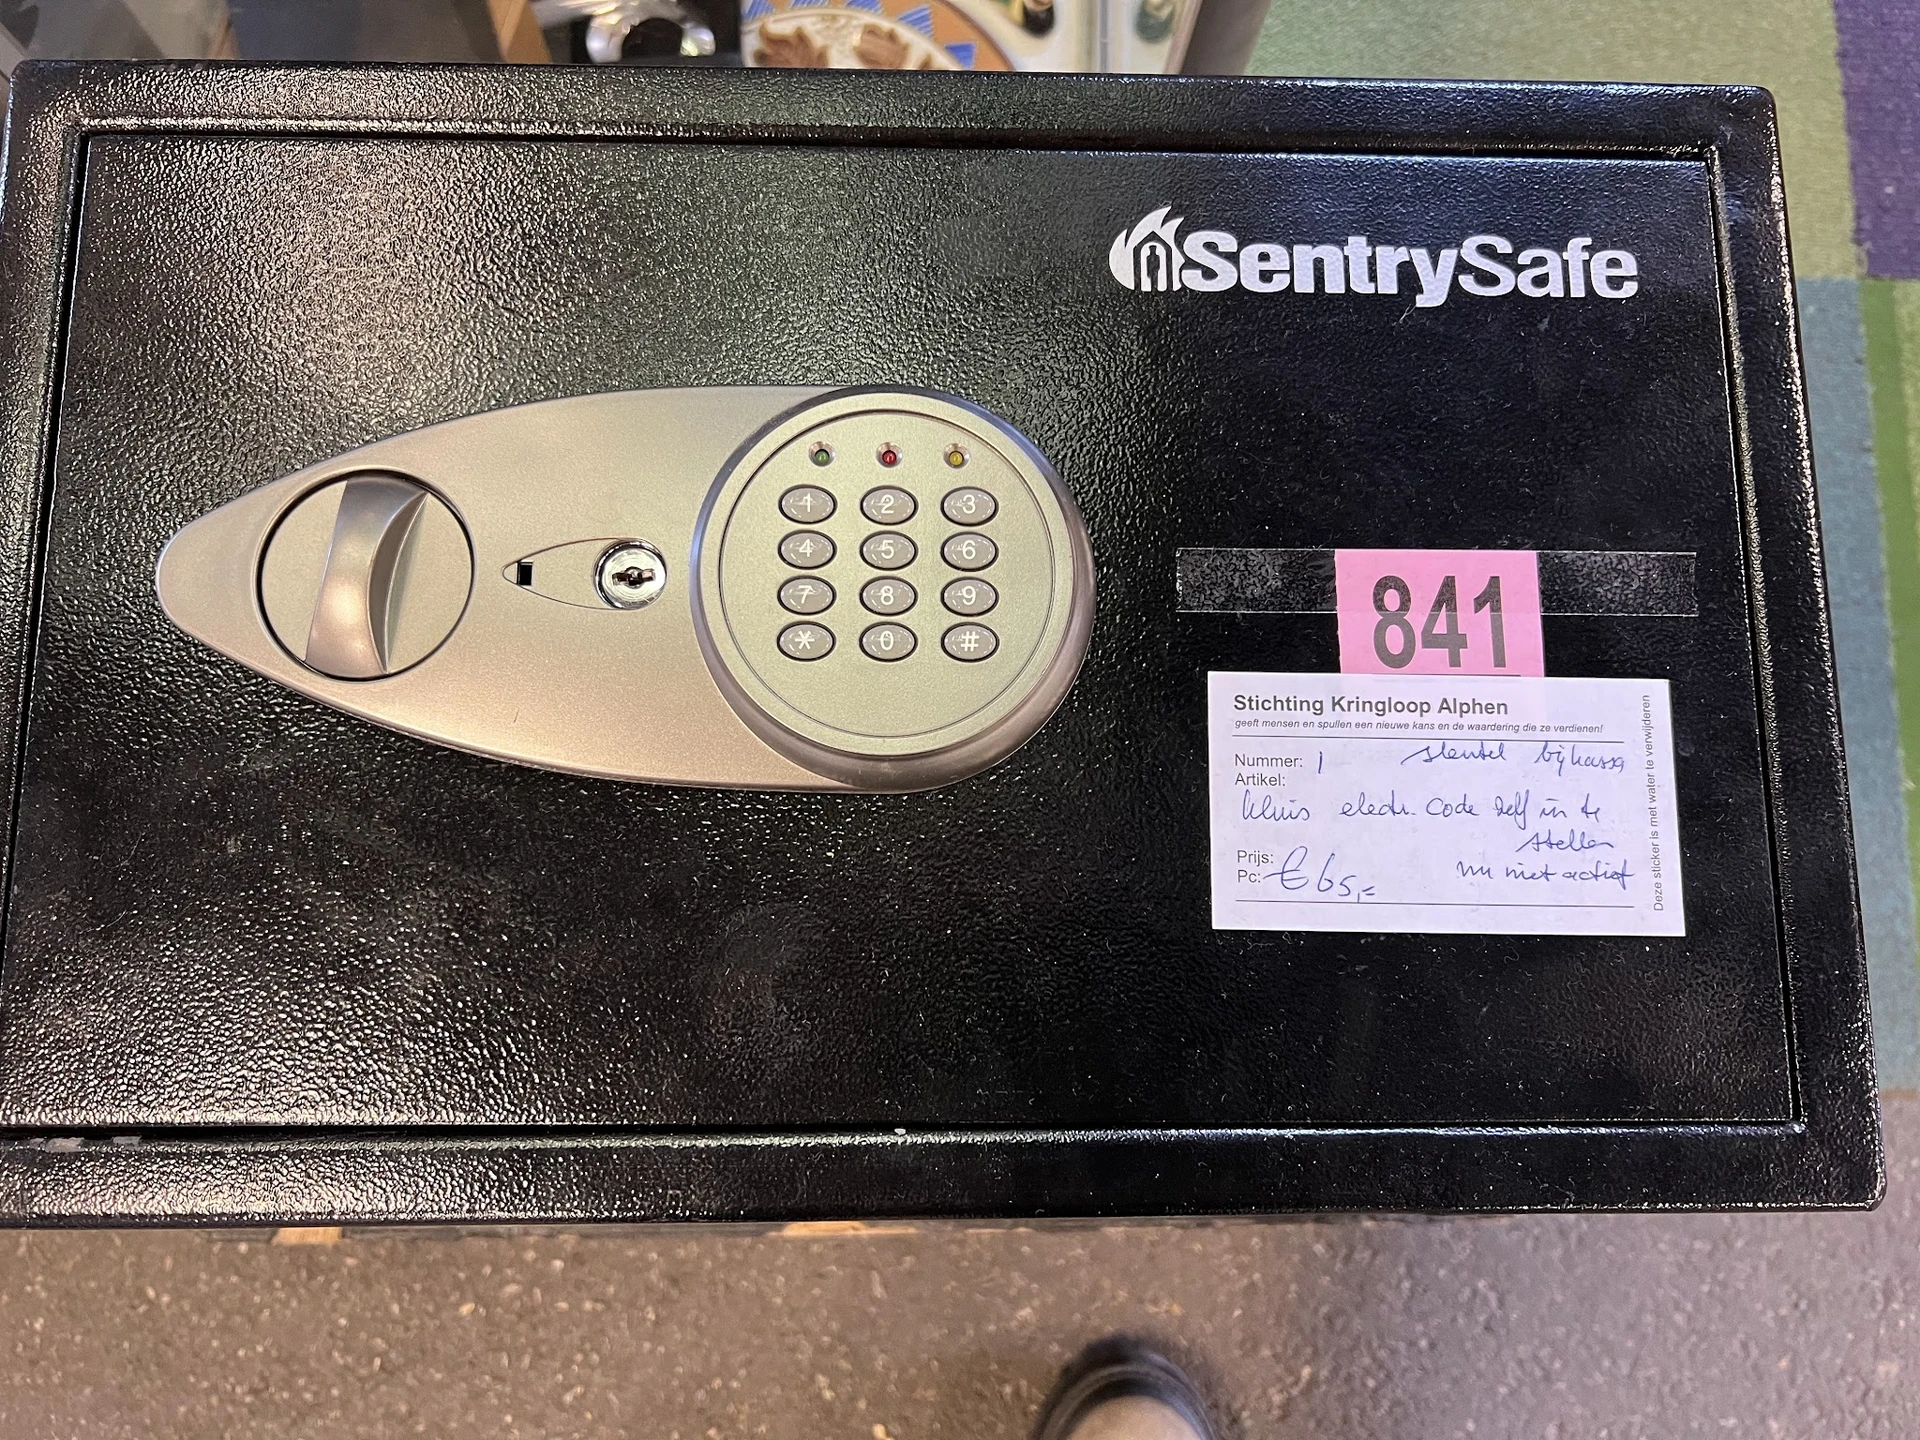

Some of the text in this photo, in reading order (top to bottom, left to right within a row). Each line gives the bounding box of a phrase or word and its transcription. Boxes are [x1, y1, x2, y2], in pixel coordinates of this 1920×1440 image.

[1181, 230, 1639, 308] SentrySafe
[802, 493, 976, 514] 1 2 3
[799, 538, 976, 560] 4 5 6
[799, 584, 976, 606] 7 8 9
[1372, 575, 1506, 669] 841
[880, 630, 894, 651] 0
[960, 631, 980, 652] #
[1234, 694, 1508, 718] Stichting Kringloop Alphen
[1235, 719, 1604, 733] geeft mensen en spullen een nieuwe kans en de waardering die ze verdienen!
[1235, 753, 1303, 768] Nummer:
[1234, 772, 1286, 786] Artikel:
[1539, 798, 1567, 818] in
[1642, 695, 1664, 911] Deze sticker is met water te verwijderen
[1237, 850, 1274, 866] Prijs:
[1237, 869, 1261, 883] Pc:
[1505, 862, 1557, 882] niet
